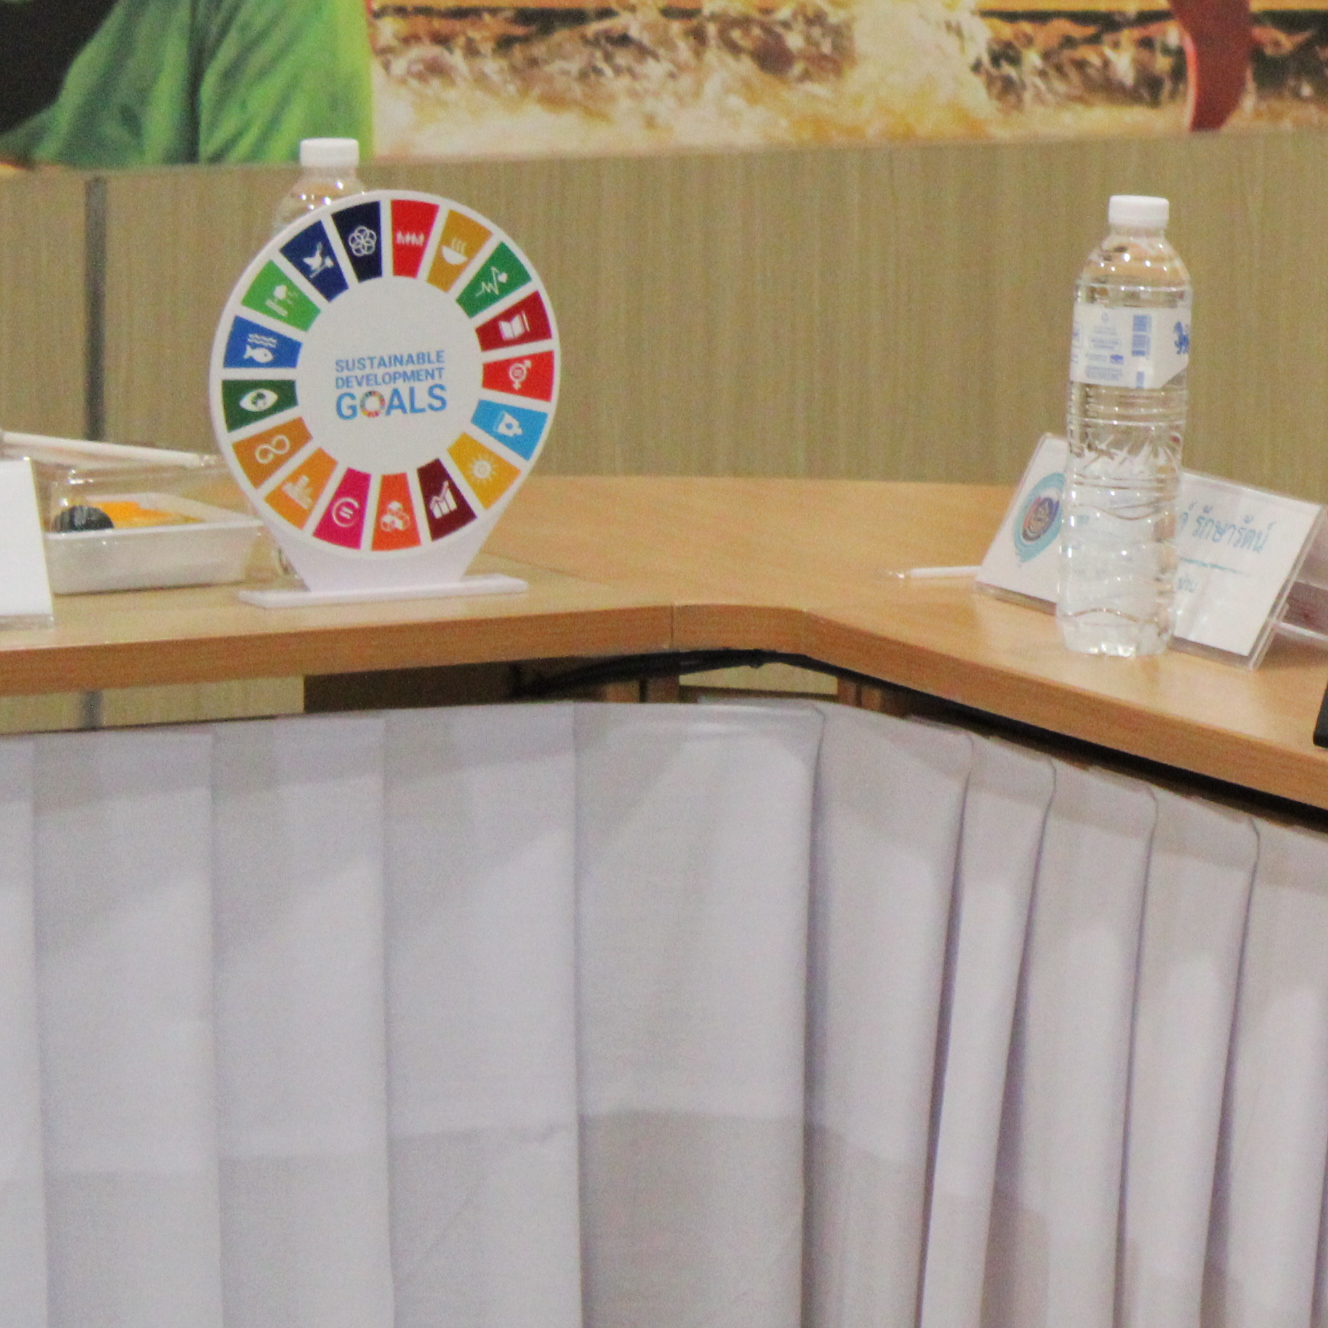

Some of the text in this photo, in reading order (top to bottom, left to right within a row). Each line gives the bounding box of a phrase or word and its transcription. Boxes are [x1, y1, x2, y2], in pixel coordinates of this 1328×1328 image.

[335, 349, 446, 373] SUSTAINABLE
[335, 367, 446, 390] DEVELOPMENT
[335, 383, 448, 420] GOALS
